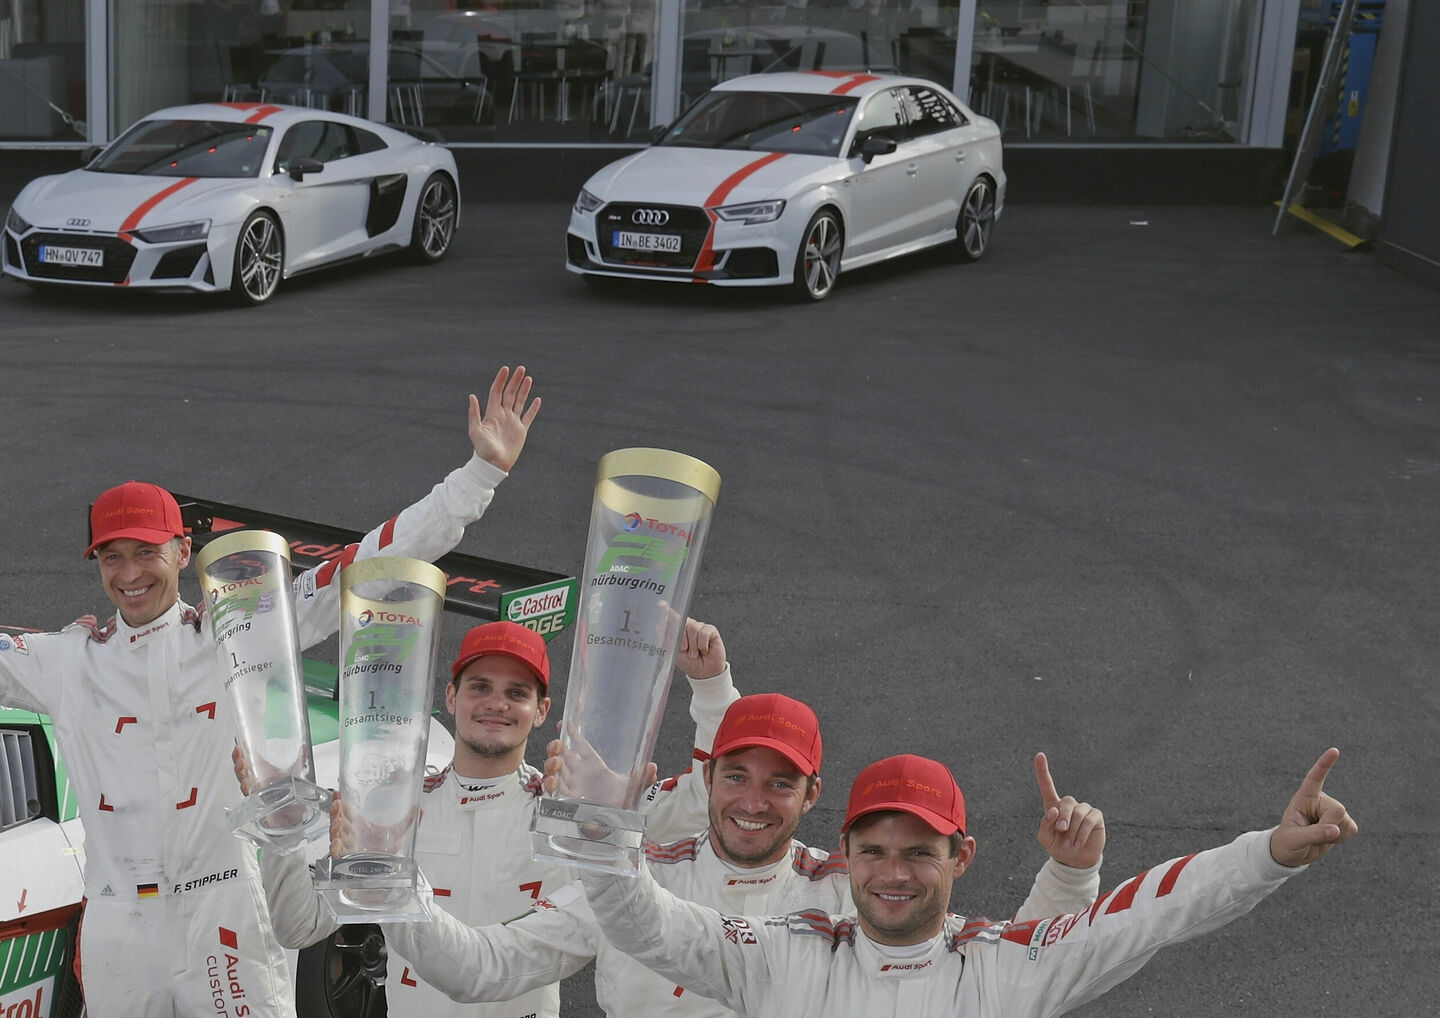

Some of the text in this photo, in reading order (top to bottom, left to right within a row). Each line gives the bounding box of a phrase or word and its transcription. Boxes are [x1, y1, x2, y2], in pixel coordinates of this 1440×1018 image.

[621, 234, 679, 250] IN BE 3402
[45, 247, 101, 264] HN QV 747
[646, 518, 695, 543] TOTAL
[610, 565, 629, 573] ADAC
[220, 578, 263, 593] TOTAL
[592, 574, 666, 595] nürburgring
[523, 590, 564, 616] Castrol
[378, 611, 424, 627] TOTAL
[520, 612, 567, 635] DGE
[137, 622, 169, 638] Audi Sport
[587, 633, 667, 657] Gesamtsieger
[343, 662, 403, 679] nürburgring
[344, 713, 413, 728] Gesamtsieger
[487, 791, 505, 800] Sport
[185, 869, 238, 892] STIPPLER
[914, 960, 932, 970] Sport
[225, 953, 245, 1000] Audi
